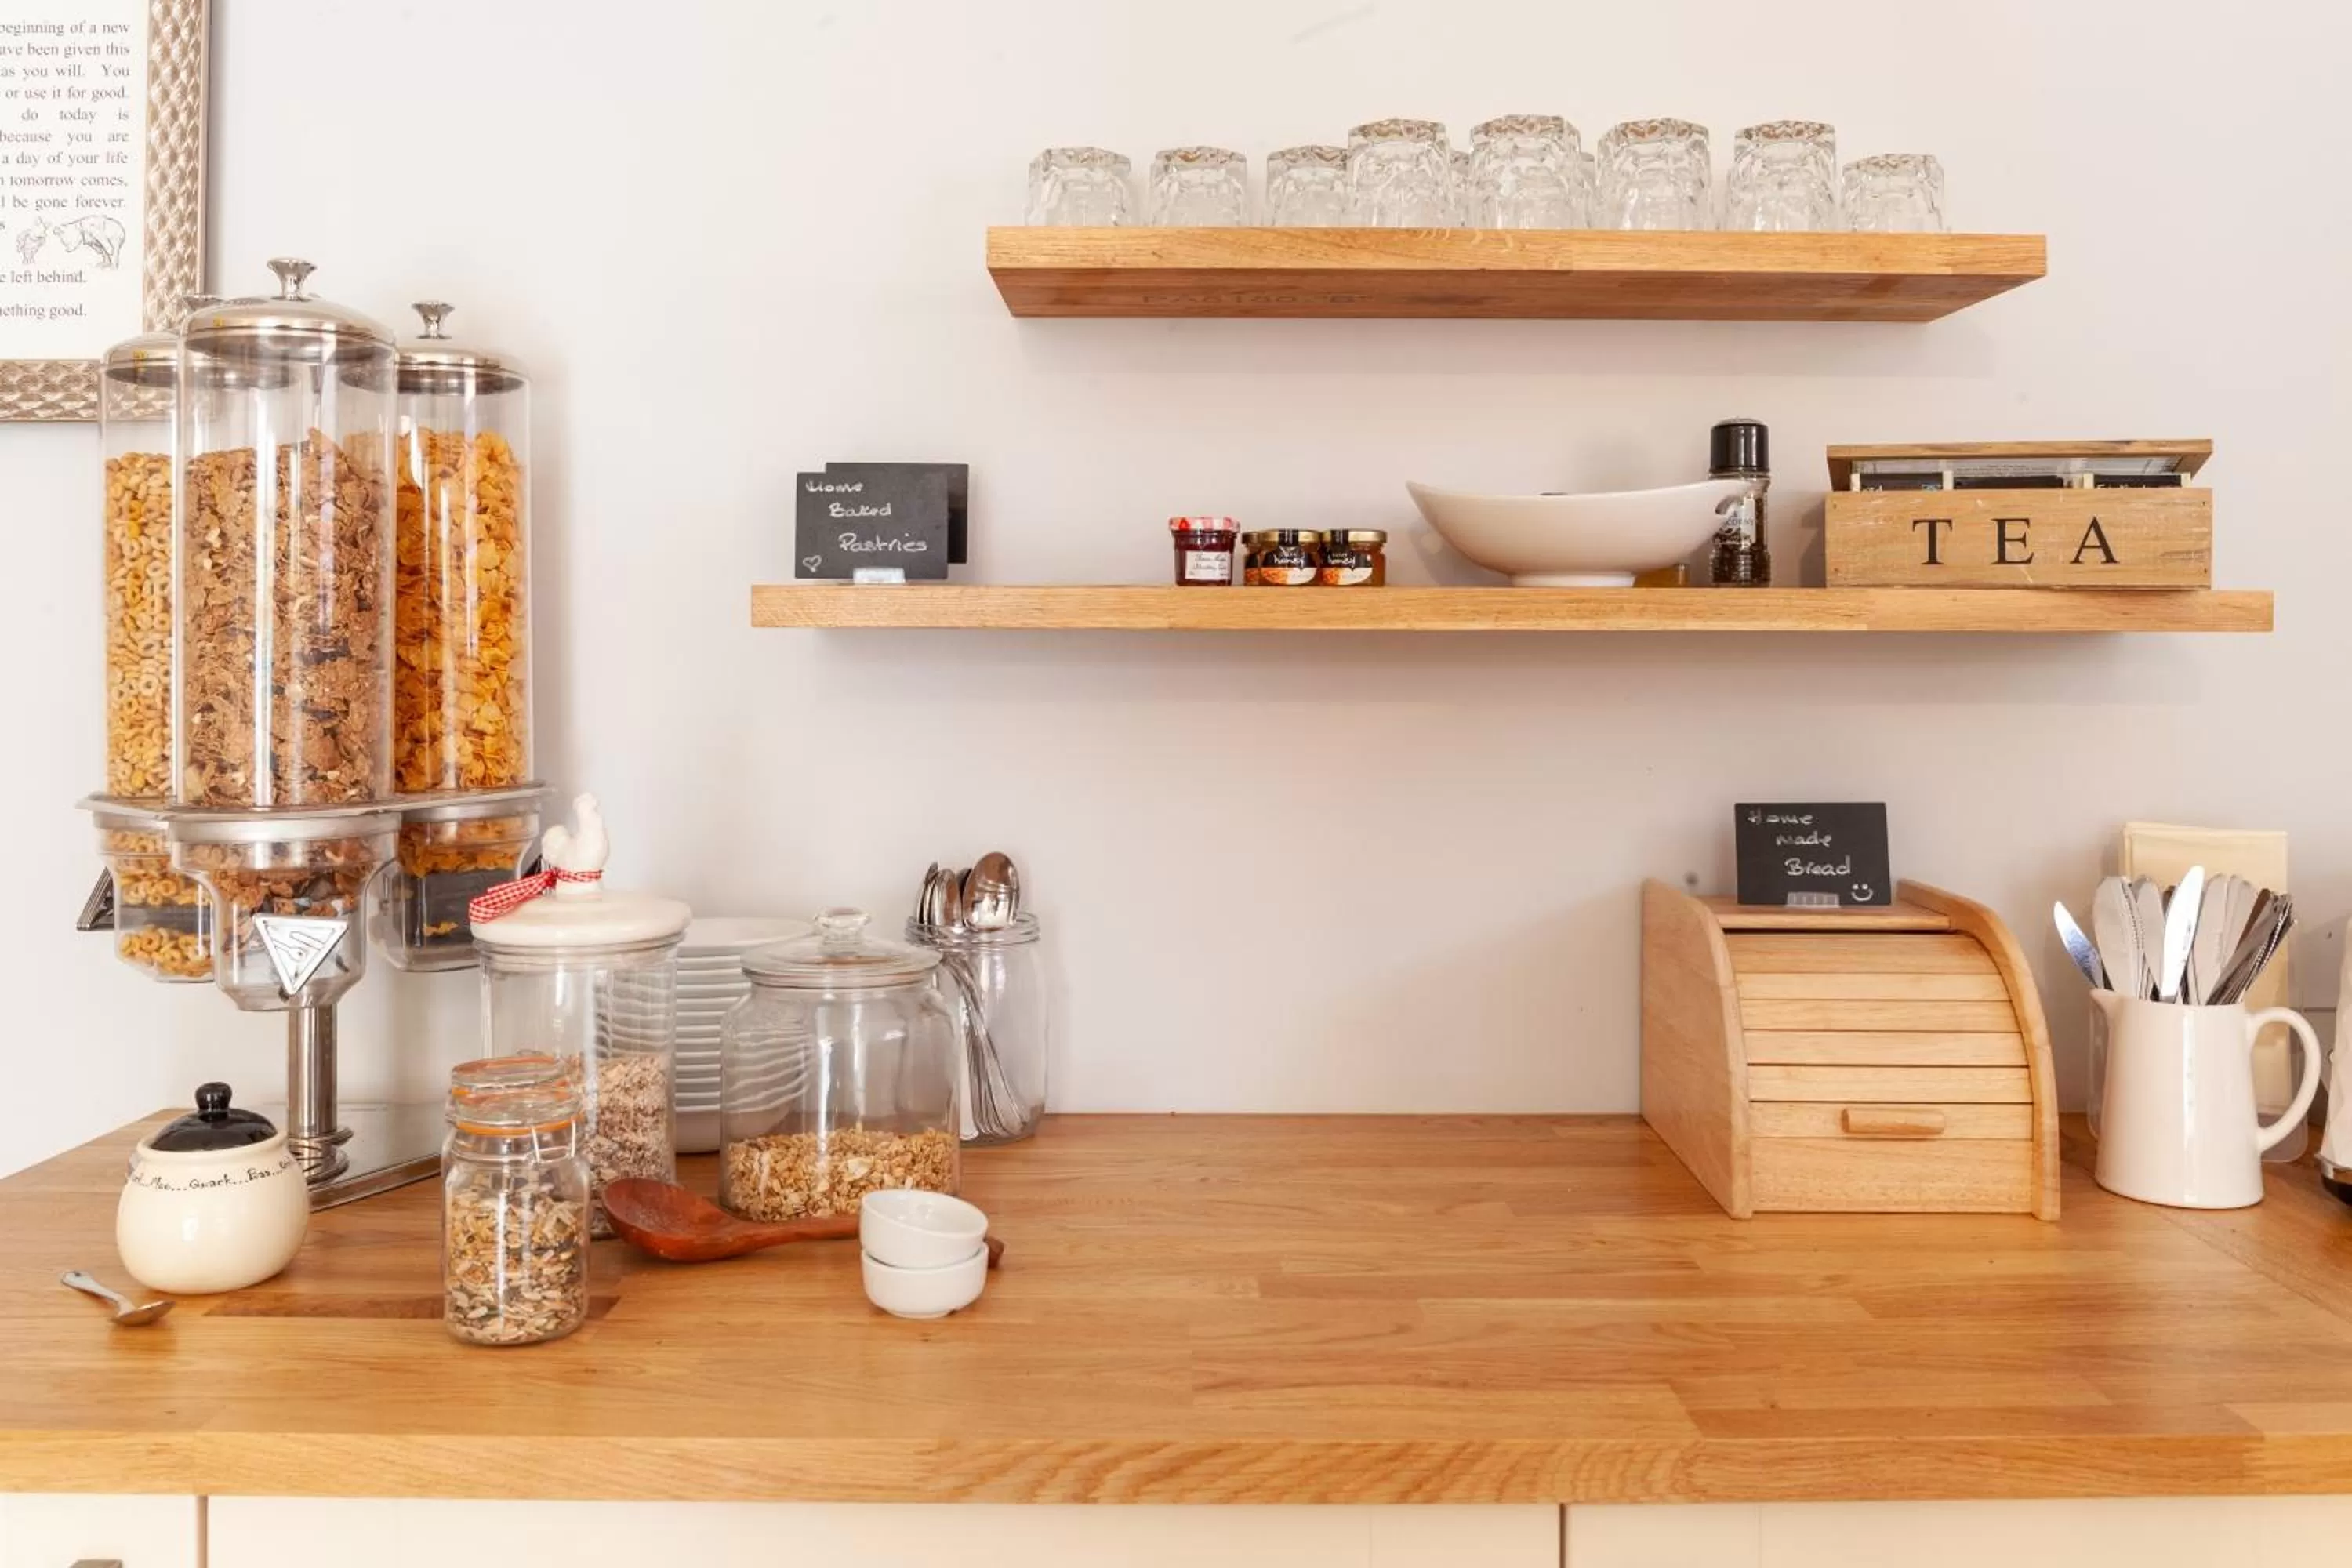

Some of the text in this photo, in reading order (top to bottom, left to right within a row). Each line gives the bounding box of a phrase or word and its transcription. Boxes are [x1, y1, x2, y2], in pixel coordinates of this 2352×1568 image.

[70, 21, 86, 34] of
[89, 25, 97, 34] a
[103, 25, 130, 34] new
[27, 42, 59, 56] been
[64, 42, 101, 59] given
[106, 42, 130, 56] this
[23, 68, 48, 81] you
[102, 64, 129, 77] You
[5, 85, 128, 102] or use it for good.
[21, 108, 129, 124] do today is
[68, 133, 92, 146] you
[107, 133, 129, 142] are
[16, 151, 40, 168] day
[47, 152, 63, 164] of
[67, 154, 100, 167] your
[106, 152, 128, 164] life
[9, 176, 74, 186] tomorrow
[13, 194, 28, 208] be
[35, 198, 68, 211] gone
[11, 270, 32, 283] left
[37, 270, 86, 283] behind.
[49, 304, 86, 320] good.
[805, 479, 862, 492] Home
[828, 502, 891, 517] Baked
[838, 532, 927, 552] Pastries
[1911, 516, 2121, 565] TEA
[1747, 808, 1813, 825] Home
[1775, 831, 1832, 847] made
[1784, 855, 1851, 876] Bread
